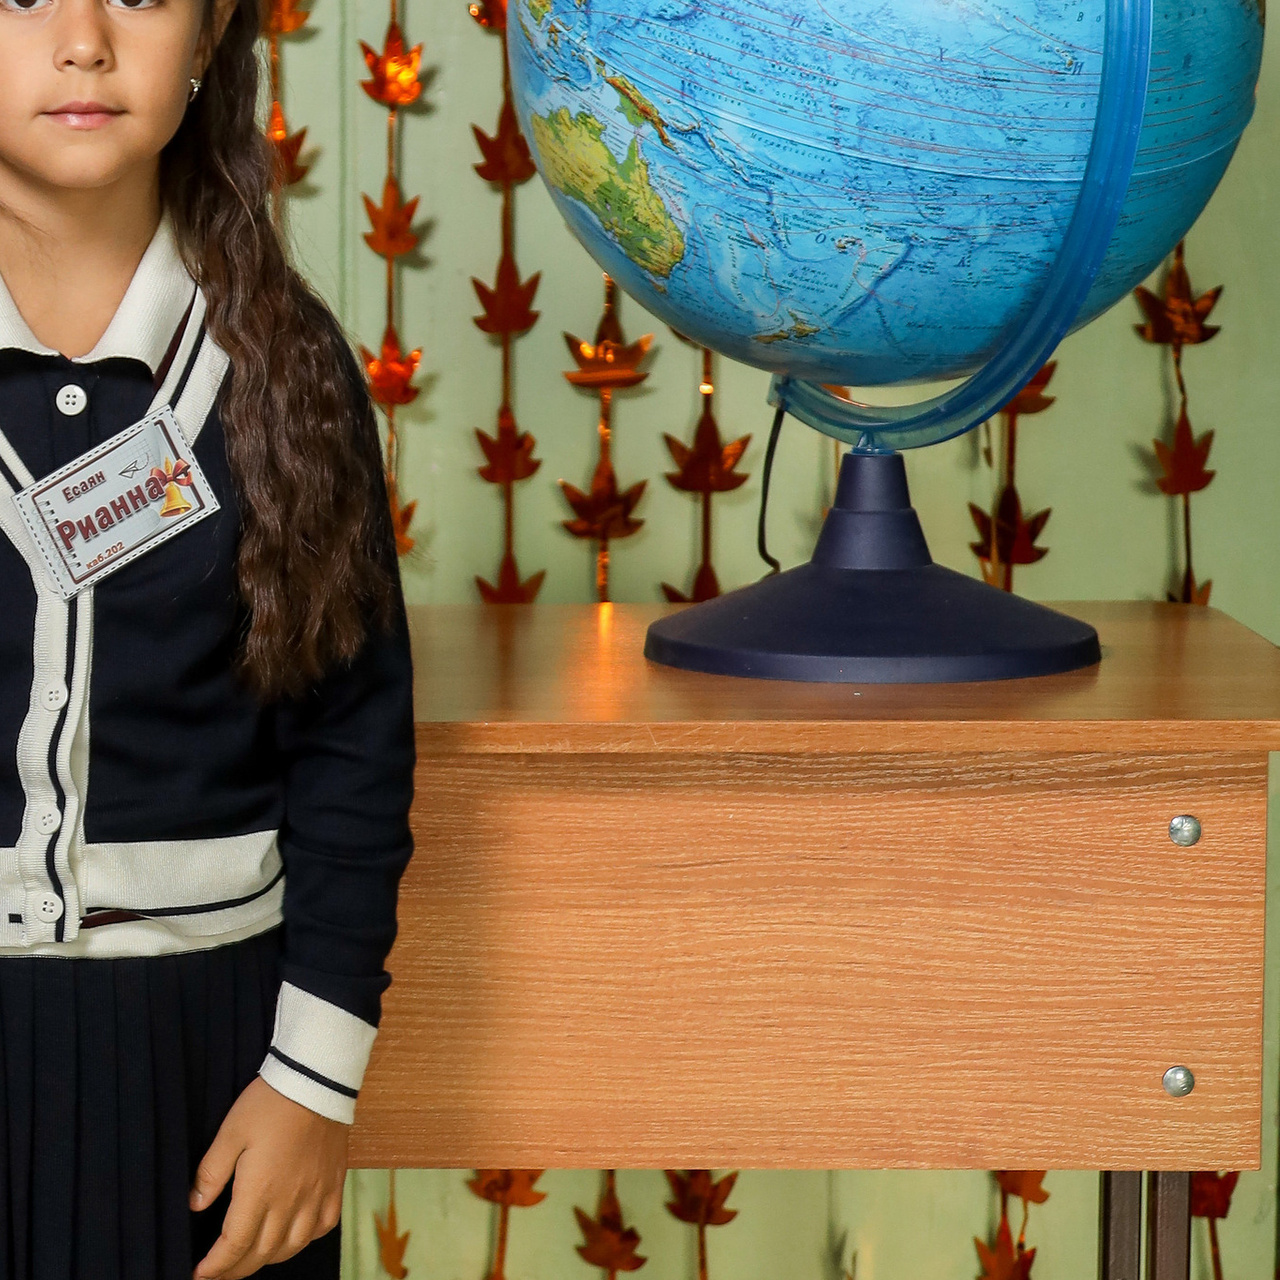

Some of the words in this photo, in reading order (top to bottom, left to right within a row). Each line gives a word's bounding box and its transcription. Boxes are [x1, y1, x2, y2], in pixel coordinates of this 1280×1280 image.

[61, 470, 106, 504] Есаян
[55, 476, 167, 552] Рианна
[86, 541, 125, 570] каб.202
